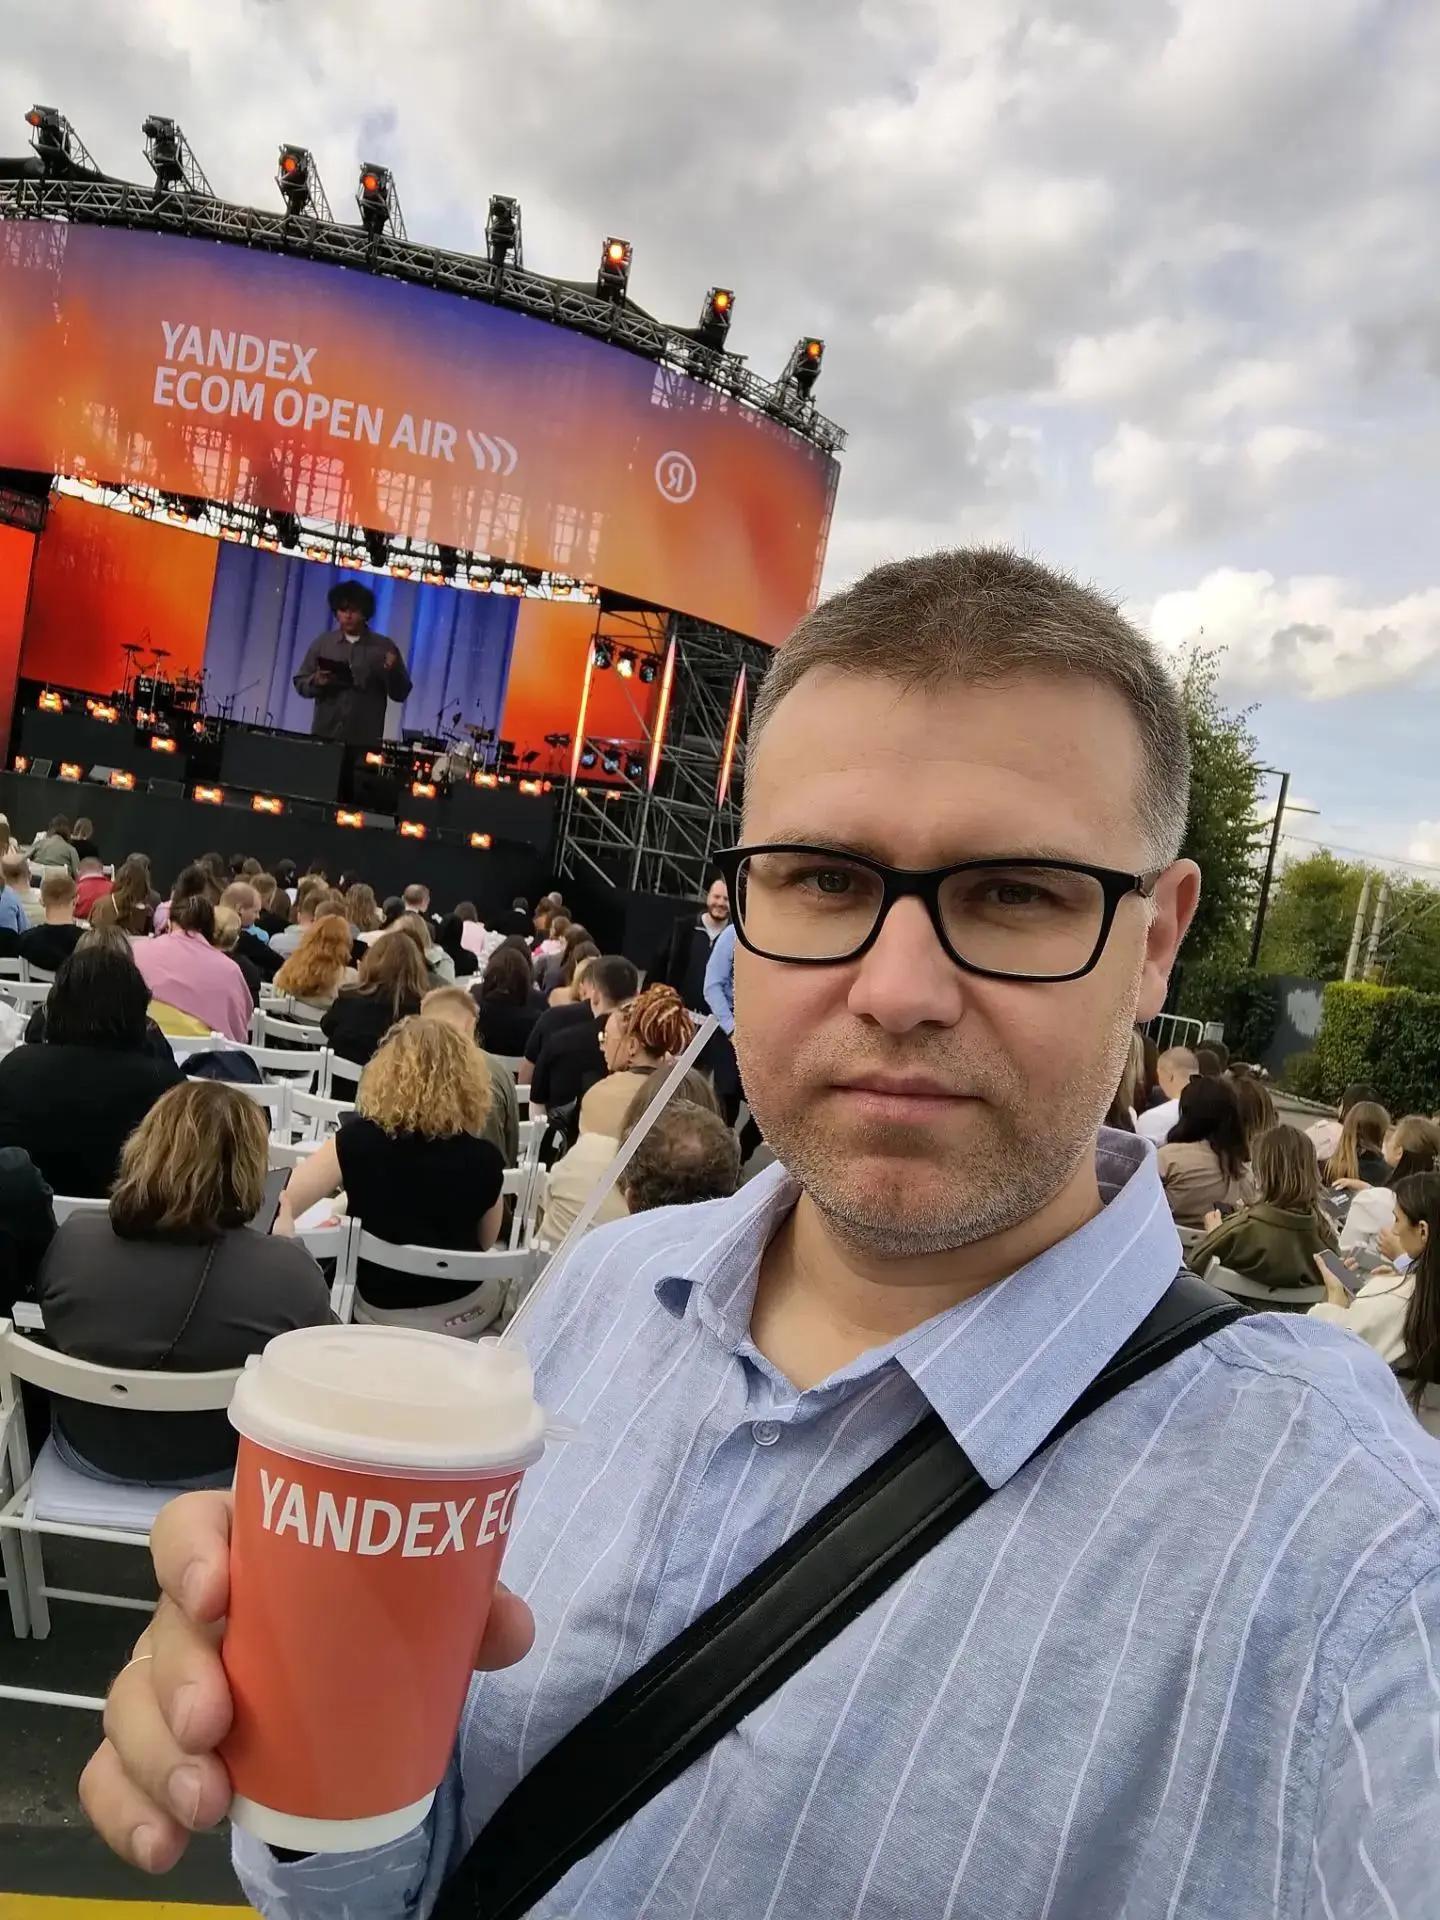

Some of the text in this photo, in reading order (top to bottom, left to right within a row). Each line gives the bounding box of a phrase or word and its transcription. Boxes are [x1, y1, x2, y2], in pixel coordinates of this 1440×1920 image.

[160, 320, 317, 386] YANDEX
[152, 366, 455, 463] ECOM OPEN AIR
[259, 1468, 477, 1558] YANDEX
